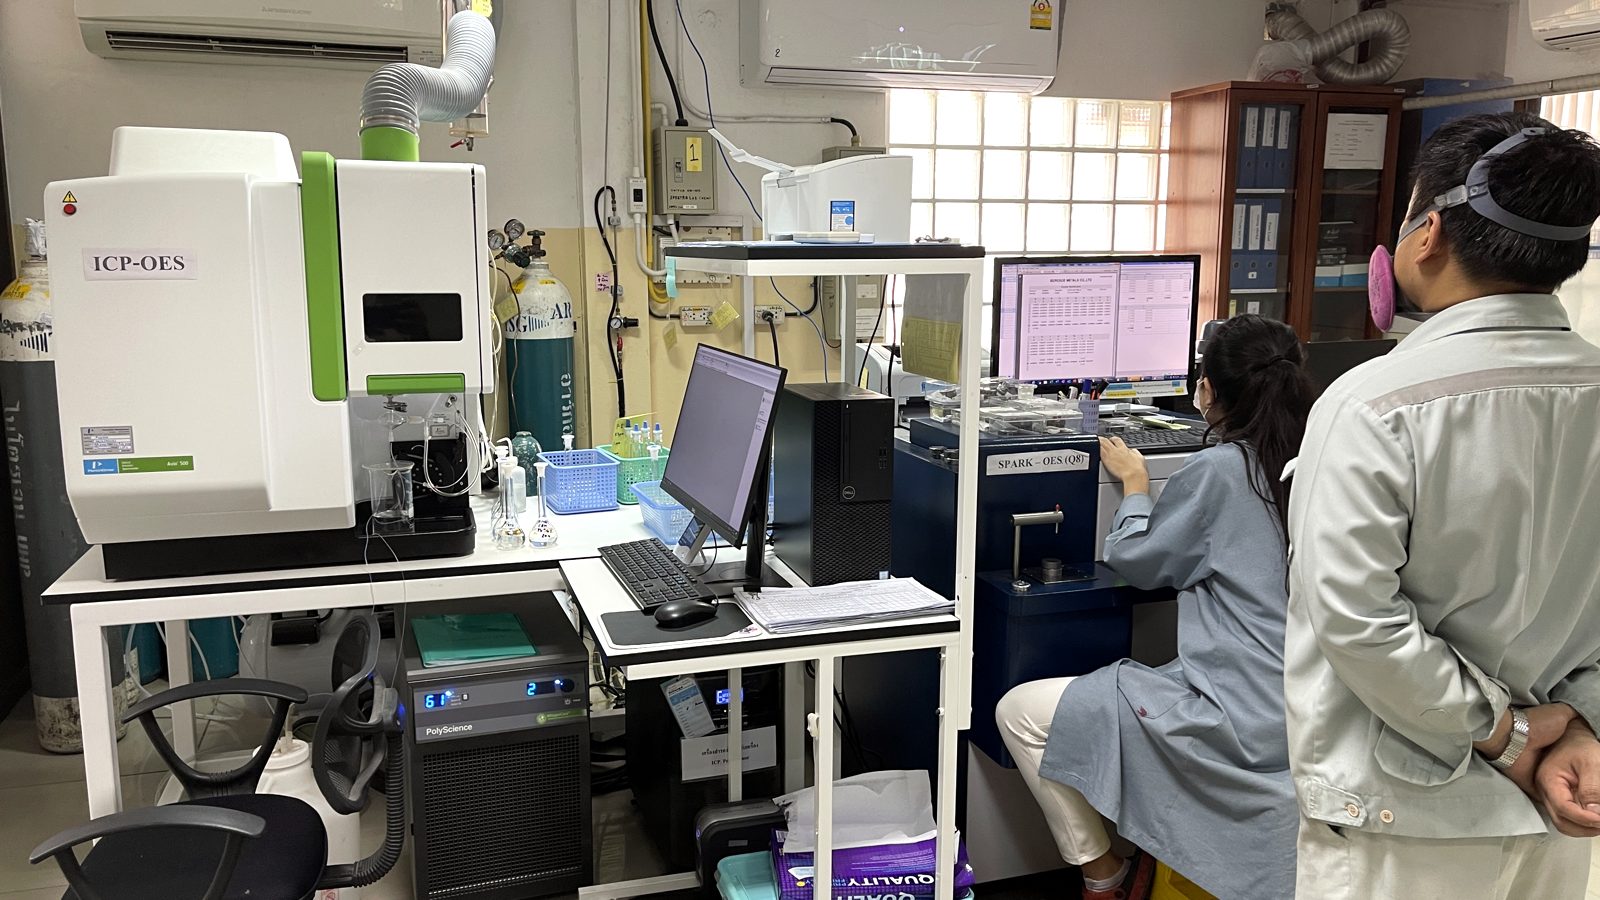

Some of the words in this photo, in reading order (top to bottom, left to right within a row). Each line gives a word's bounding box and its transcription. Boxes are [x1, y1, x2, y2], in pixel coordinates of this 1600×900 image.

[775, 48, 781, 58] 2
[689, 143, 699, 162] 1
[93, 255, 185, 271] ICP-OES
[998, 458, 1033, 469] SPARK
[1042, 456, 1063, 466] OES
[1064, 454, 1085, 466] (Q8)
[527, 683, 537, 695] 2
[425, 694, 446, 708] 61
[426, 723, 473, 736] PolyScience
[847, 874, 935, 887] QUALITY
